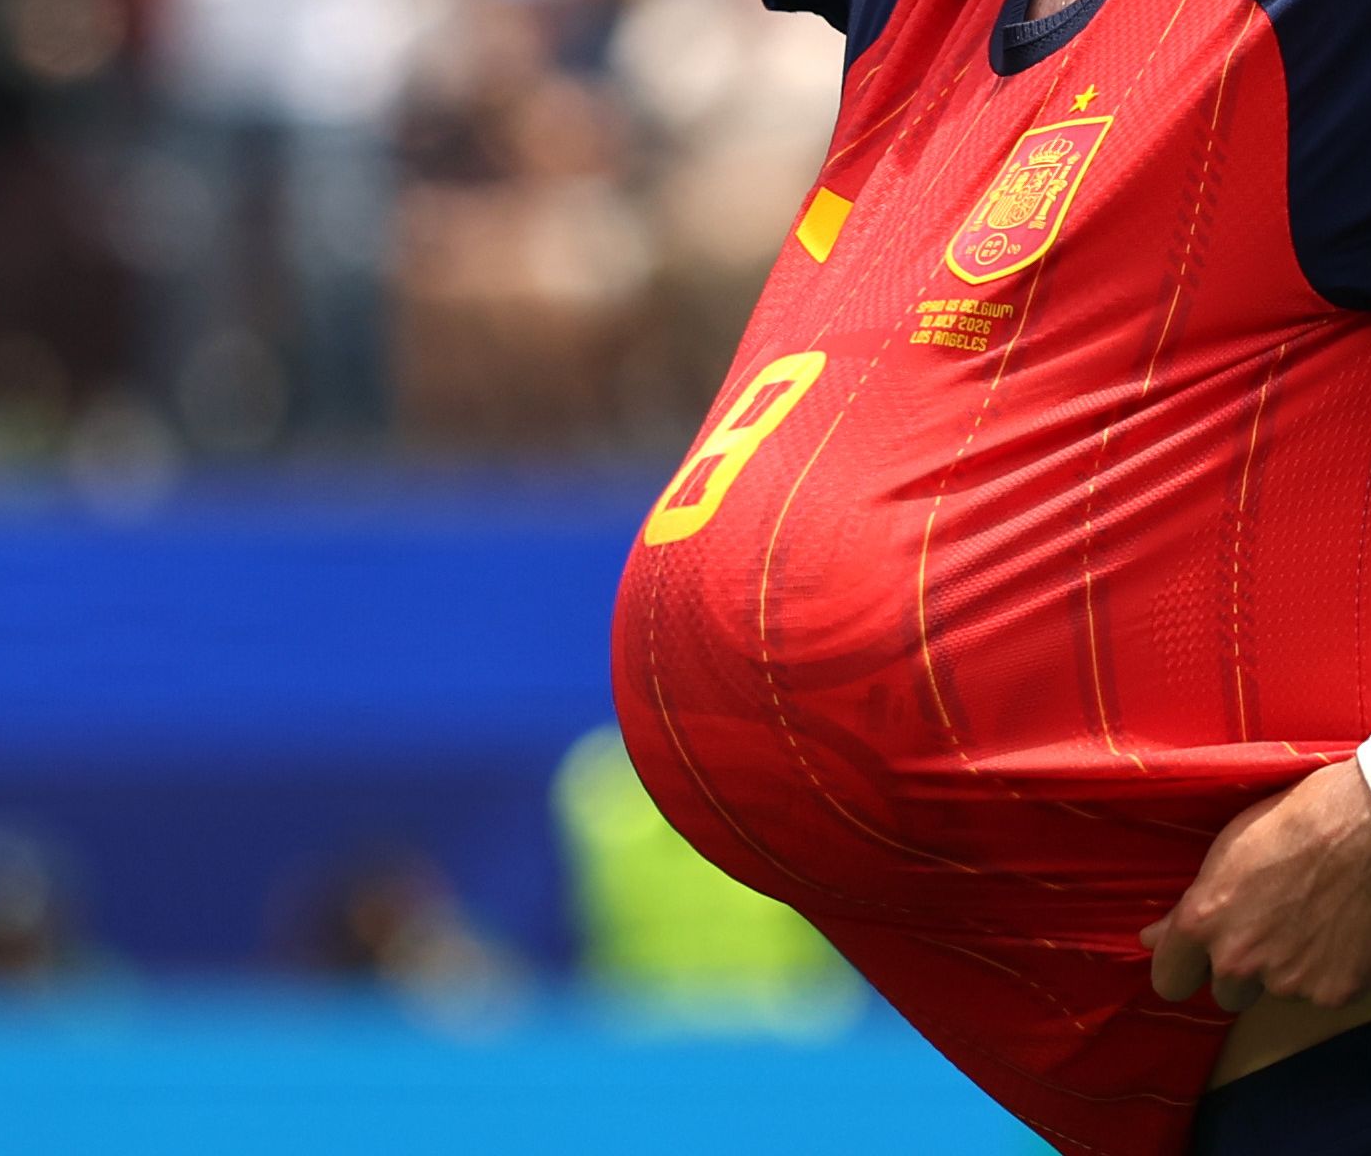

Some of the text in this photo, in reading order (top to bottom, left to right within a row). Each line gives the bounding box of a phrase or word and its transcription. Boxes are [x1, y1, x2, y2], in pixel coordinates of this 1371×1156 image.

[959, 299, 1014, 318] BELGIUM
[958, 317, 992, 335] 2026
[910, 329, 988, 351] LOS ANGELES
[644, 350, 827, 546] 8
